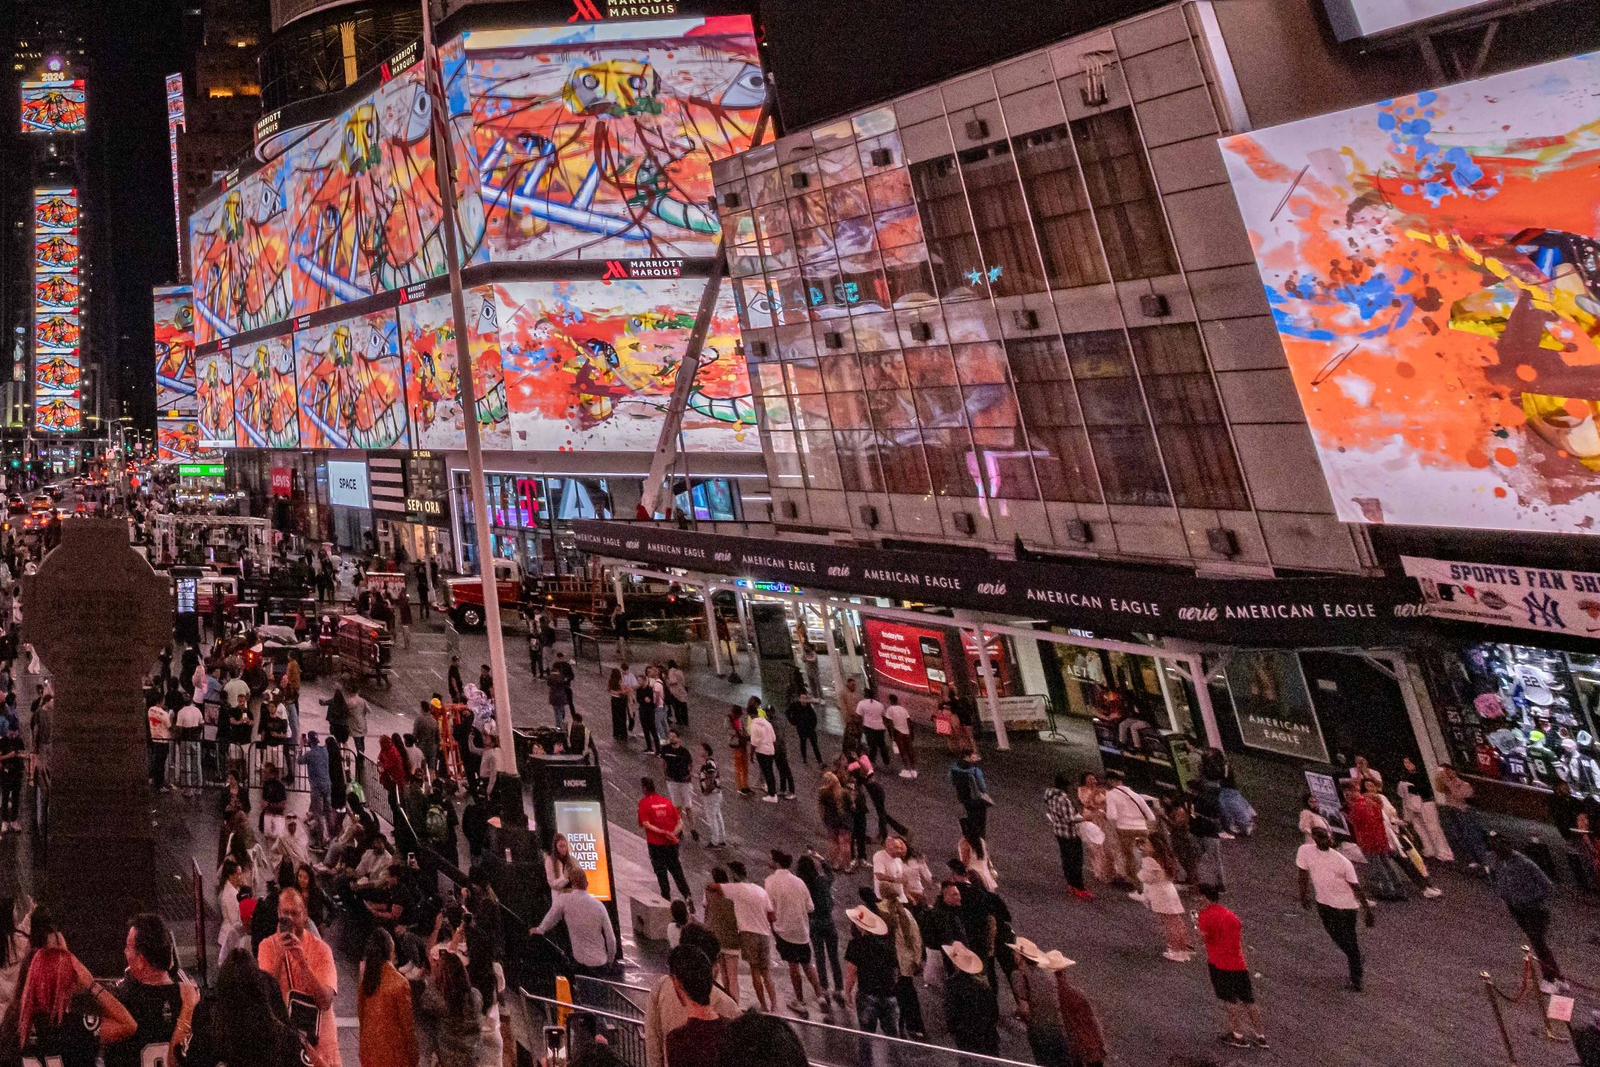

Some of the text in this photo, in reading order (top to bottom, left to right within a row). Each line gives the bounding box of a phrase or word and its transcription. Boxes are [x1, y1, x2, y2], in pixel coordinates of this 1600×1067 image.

[609, 5, 675, 17] MARQUIS
[391, 42, 417, 65] MARRIOTT
[392, 55, 416, 75] MARQUIS
[41, 72, 65, 82] 2024
[630, 260, 683, 268] MARRIOTT
[412, 450, 431, 458] SEHORA
[338, 478, 357, 490] SPACE
[603, 537, 621, 547] EAGLE
[647, 543, 682, 556] AMERICAN
[683, 548, 706, 558] EAGLE
[742, 555, 785, 568] AMERICAN
[788, 561, 816, 573] EAGLE
[827, 563, 850, 577] aerie
[864, 569, 920, 585] AMERICAN
[925, 575, 961, 590] EAGLE
[977, 580, 1007, 596] aerie
[1027, 589, 1103, 608] AMERICAN
[1110, 598, 1161, 617] EAGLE
[1178, 602, 1219, 622] aerie
[1225, 604, 1315, 619] AMERICAN
[1324, 603, 1377, 618] EAGLE
[1393, 597, 1430, 618] aerie
[1450, 564, 1521, 586] SPORTS
[1525, 570, 1568, 591] FAN
[881, 642, 911, 655] Broadway's
[877, 651, 890, 659] best
[904, 656, 917, 664] your
[1522, 675, 1541, 688] 22
[1249, 714, 1310, 734] AMERICAN
[1264, 728, 1301, 745] EAGLE
[567, 833, 596, 842] REFILL
[570, 842, 596, 851] YOUR
[580, 861, 597, 870] ERE
